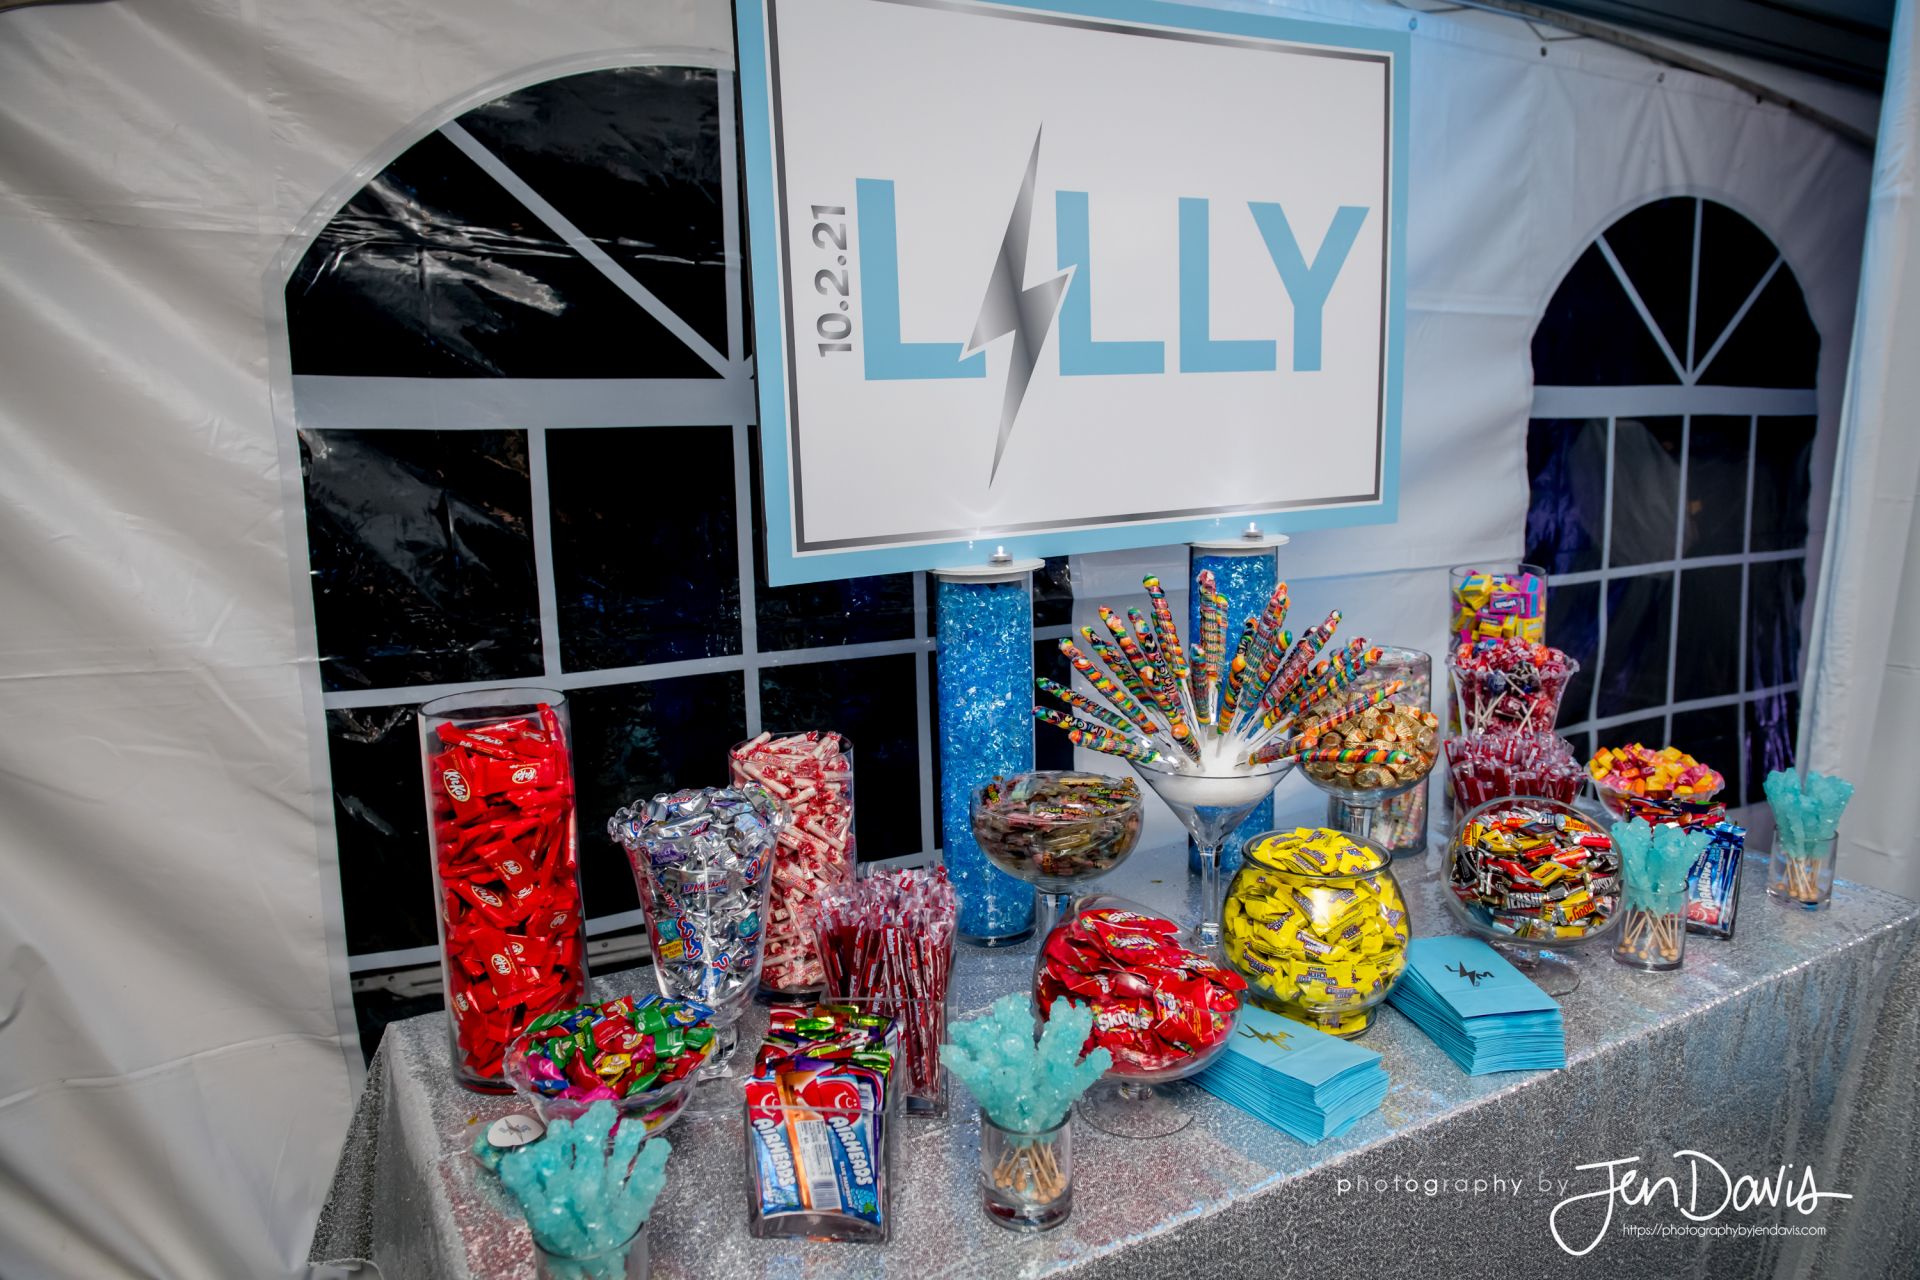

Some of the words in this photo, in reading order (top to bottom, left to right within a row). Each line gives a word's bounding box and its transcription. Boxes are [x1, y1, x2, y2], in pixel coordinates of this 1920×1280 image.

[811, 205, 852, 357] 10.2.21
[1098, 1009, 1154, 1031] Skittles
[753, 1118, 796, 1187] AIRHEADS
[828, 1116, 873, 1186] AIRHEADS
